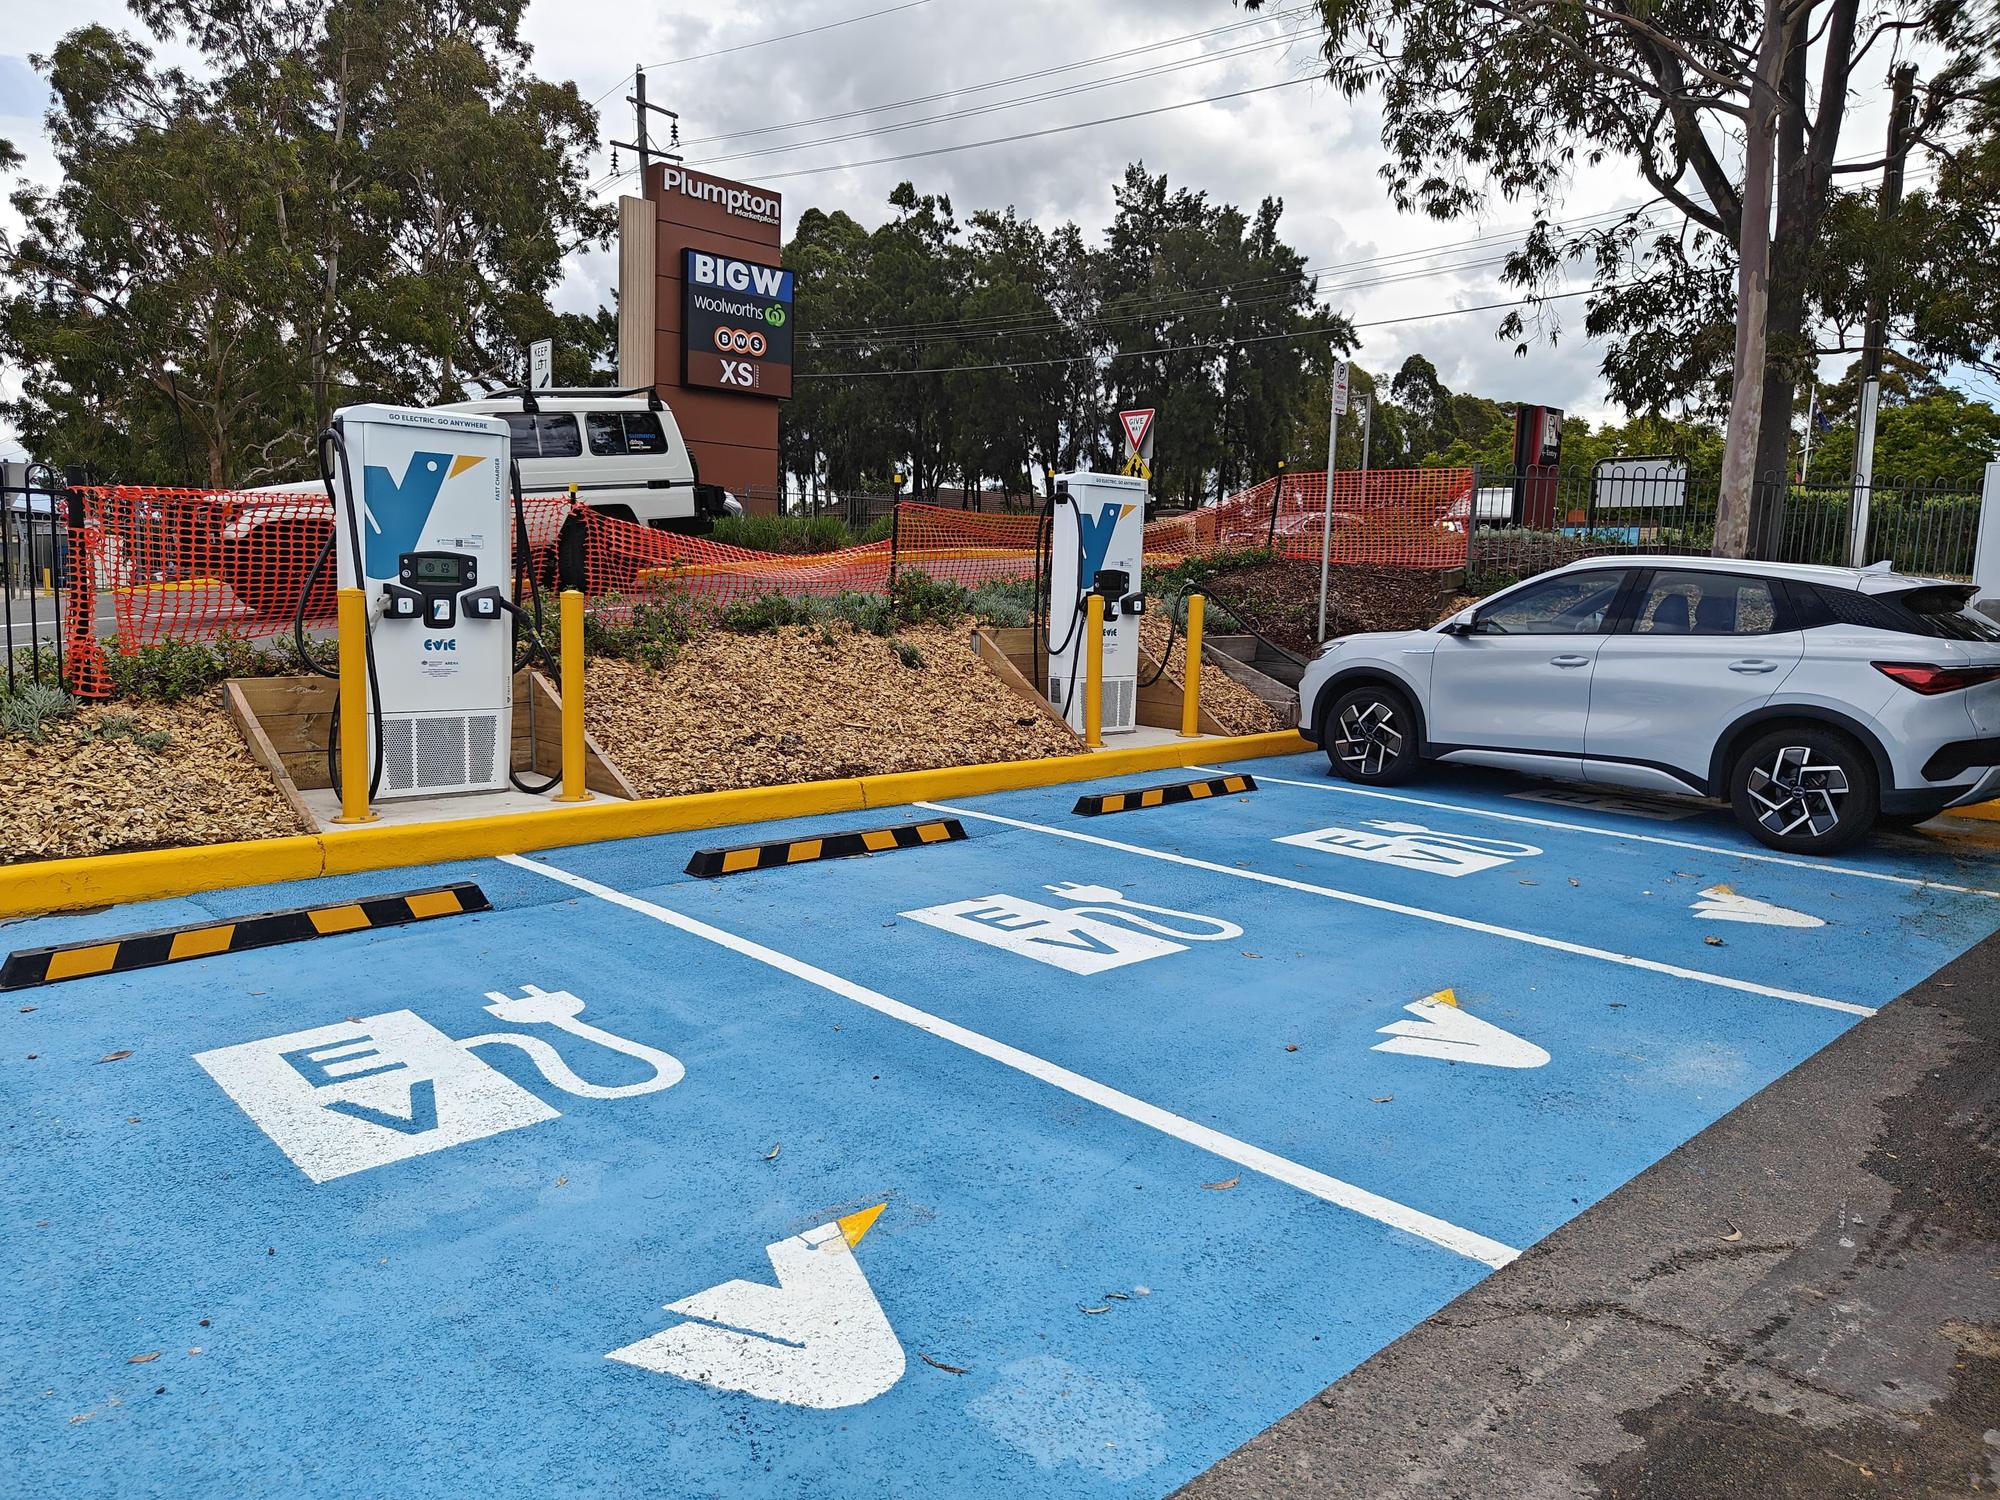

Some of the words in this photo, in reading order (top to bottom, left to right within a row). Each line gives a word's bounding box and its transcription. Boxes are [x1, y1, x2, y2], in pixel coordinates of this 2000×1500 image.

[663, 168, 779, 217] Plumpton
[734, 208, 780, 226] Marketplace
[694, 294, 764, 320] Woolworths
[721, 334, 760, 349] BWS
[534, 345, 548, 357] KEEP
[534, 359, 547, 371] LEFT
[720, 359, 754, 387] XS
[388, 413, 401, 421] GO
[450, 419, 488, 430] ANYWHERE
[1129, 417, 1144, 426] GIVE
[403, 601, 408, 610] 1
[483, 601, 489, 610] 2
[1315, 834, 1465, 865] EV
[955, 905, 1120, 956] EV
[277, 1034, 439, 1136] EV
